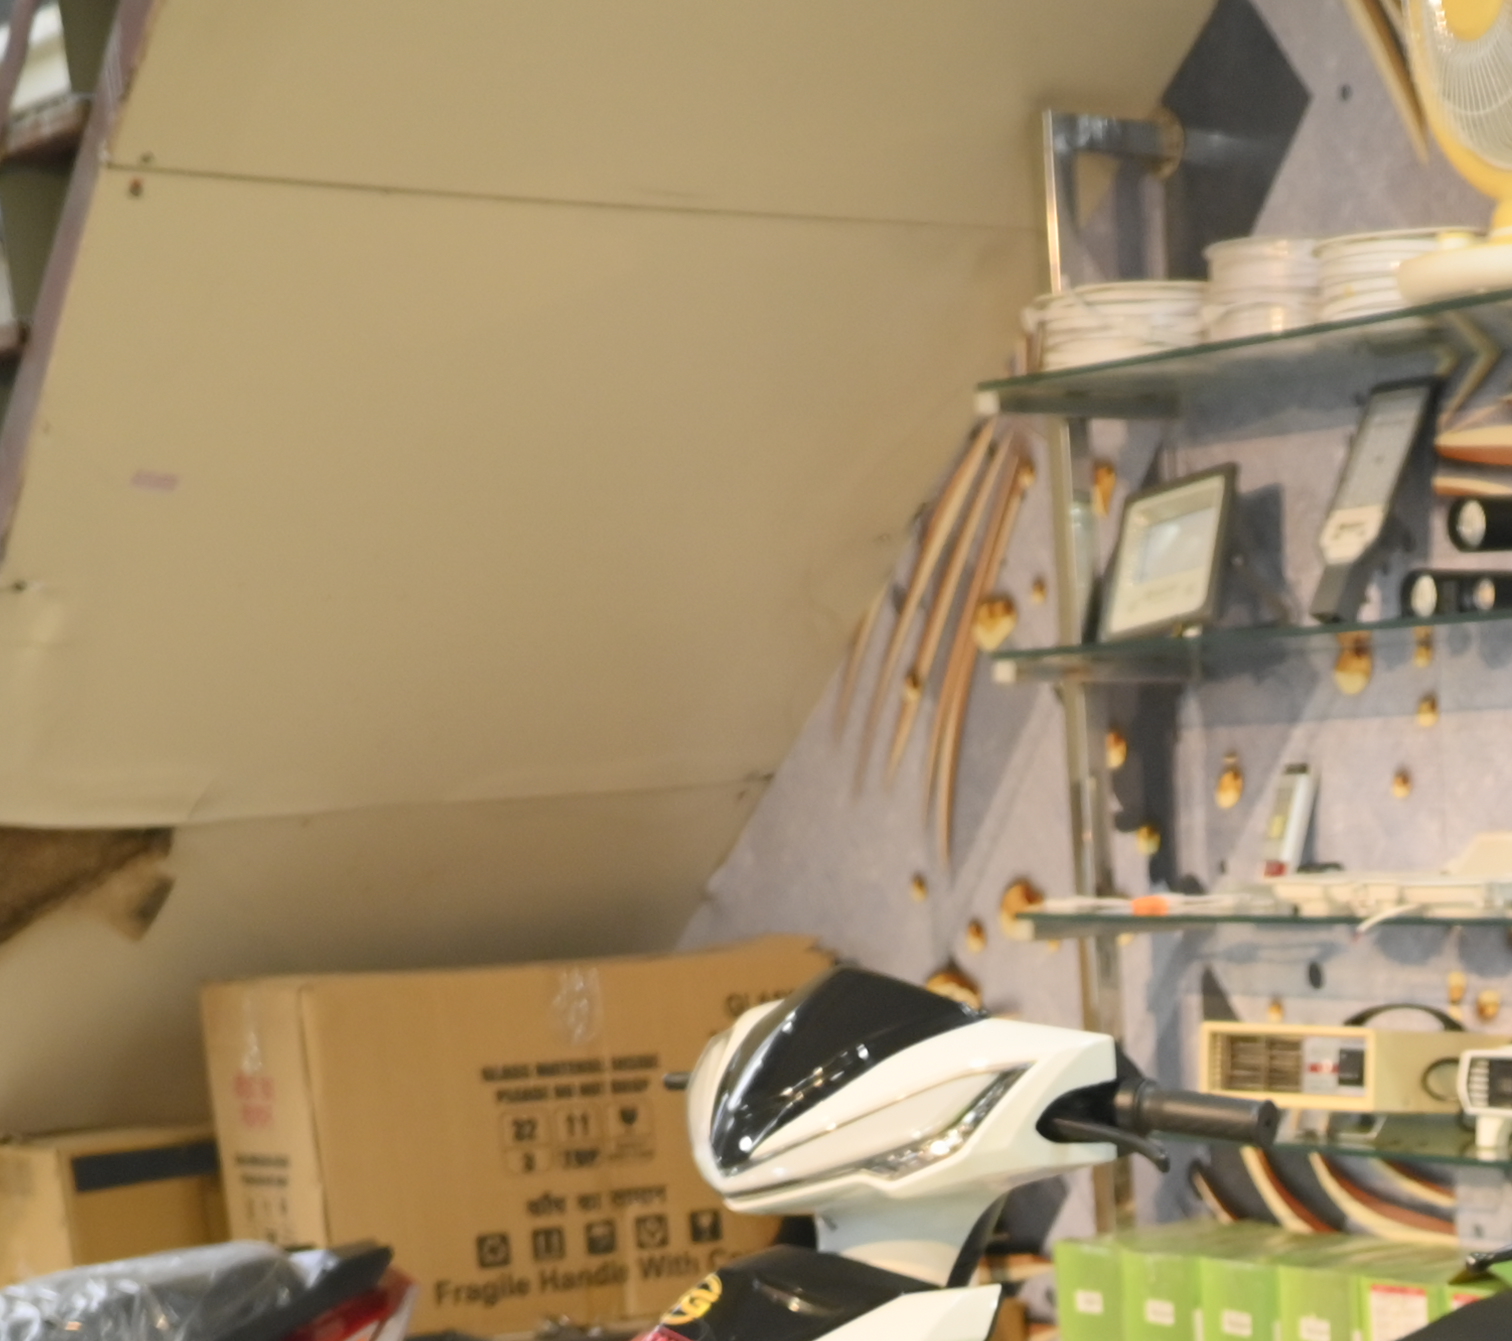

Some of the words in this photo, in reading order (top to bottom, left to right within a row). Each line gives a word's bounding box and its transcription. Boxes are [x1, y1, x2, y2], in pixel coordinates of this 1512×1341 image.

[434, 1270, 532, 1308] Fragile
[538, 1259, 629, 1295] Handle
[637, 1252, 701, 1281] With
